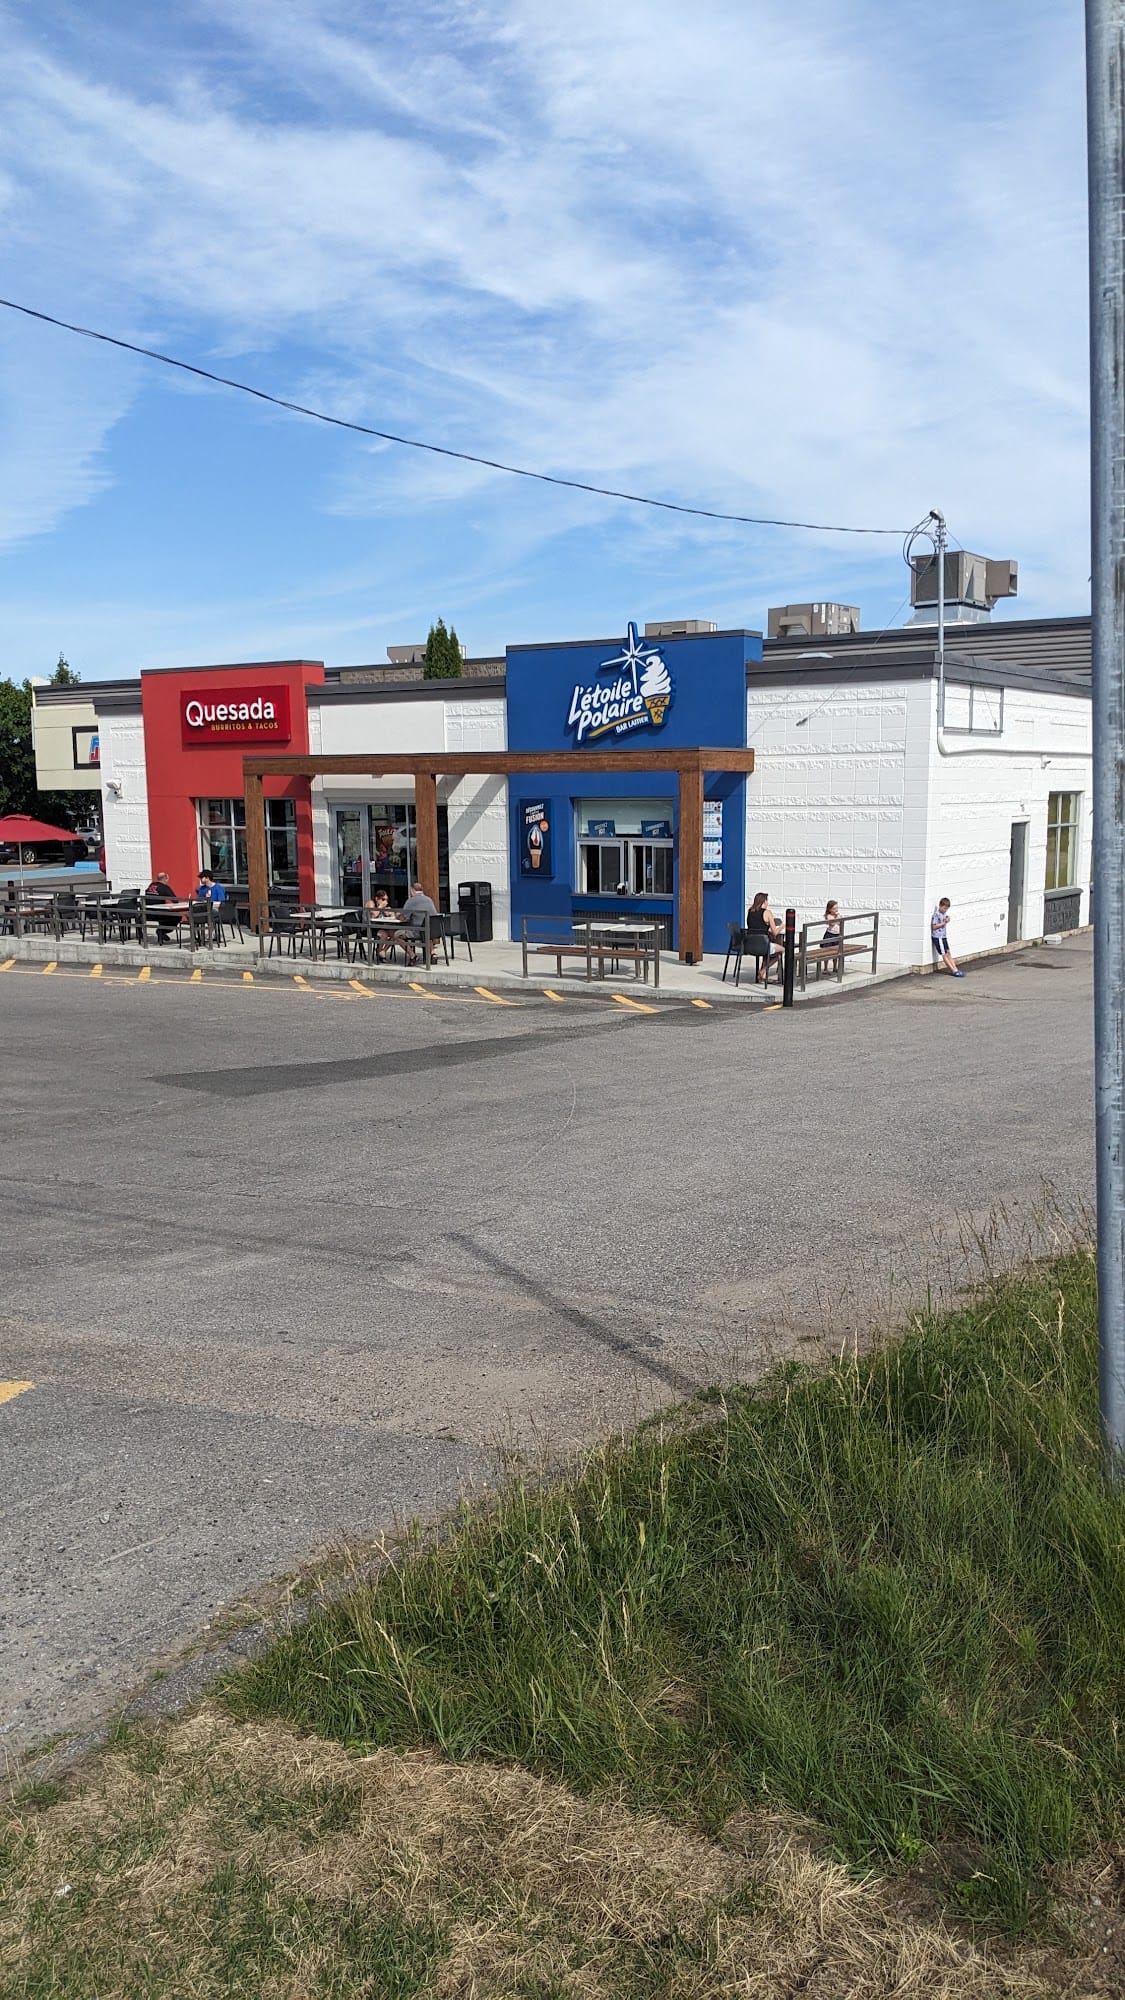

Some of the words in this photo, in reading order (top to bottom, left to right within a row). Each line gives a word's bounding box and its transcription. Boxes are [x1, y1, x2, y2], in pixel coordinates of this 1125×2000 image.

[185, 697, 275, 727] Quesada
[567, 677, 632, 725] L'étoile
[211, 723, 246, 731] BURRITOS
[247, 722, 253, 730] &
[255, 721, 279, 730] TACOS
[577, 695, 643, 741] Polaire
[615, 722, 628, 734] BAR
[525, 811, 545, 825] FUSION
